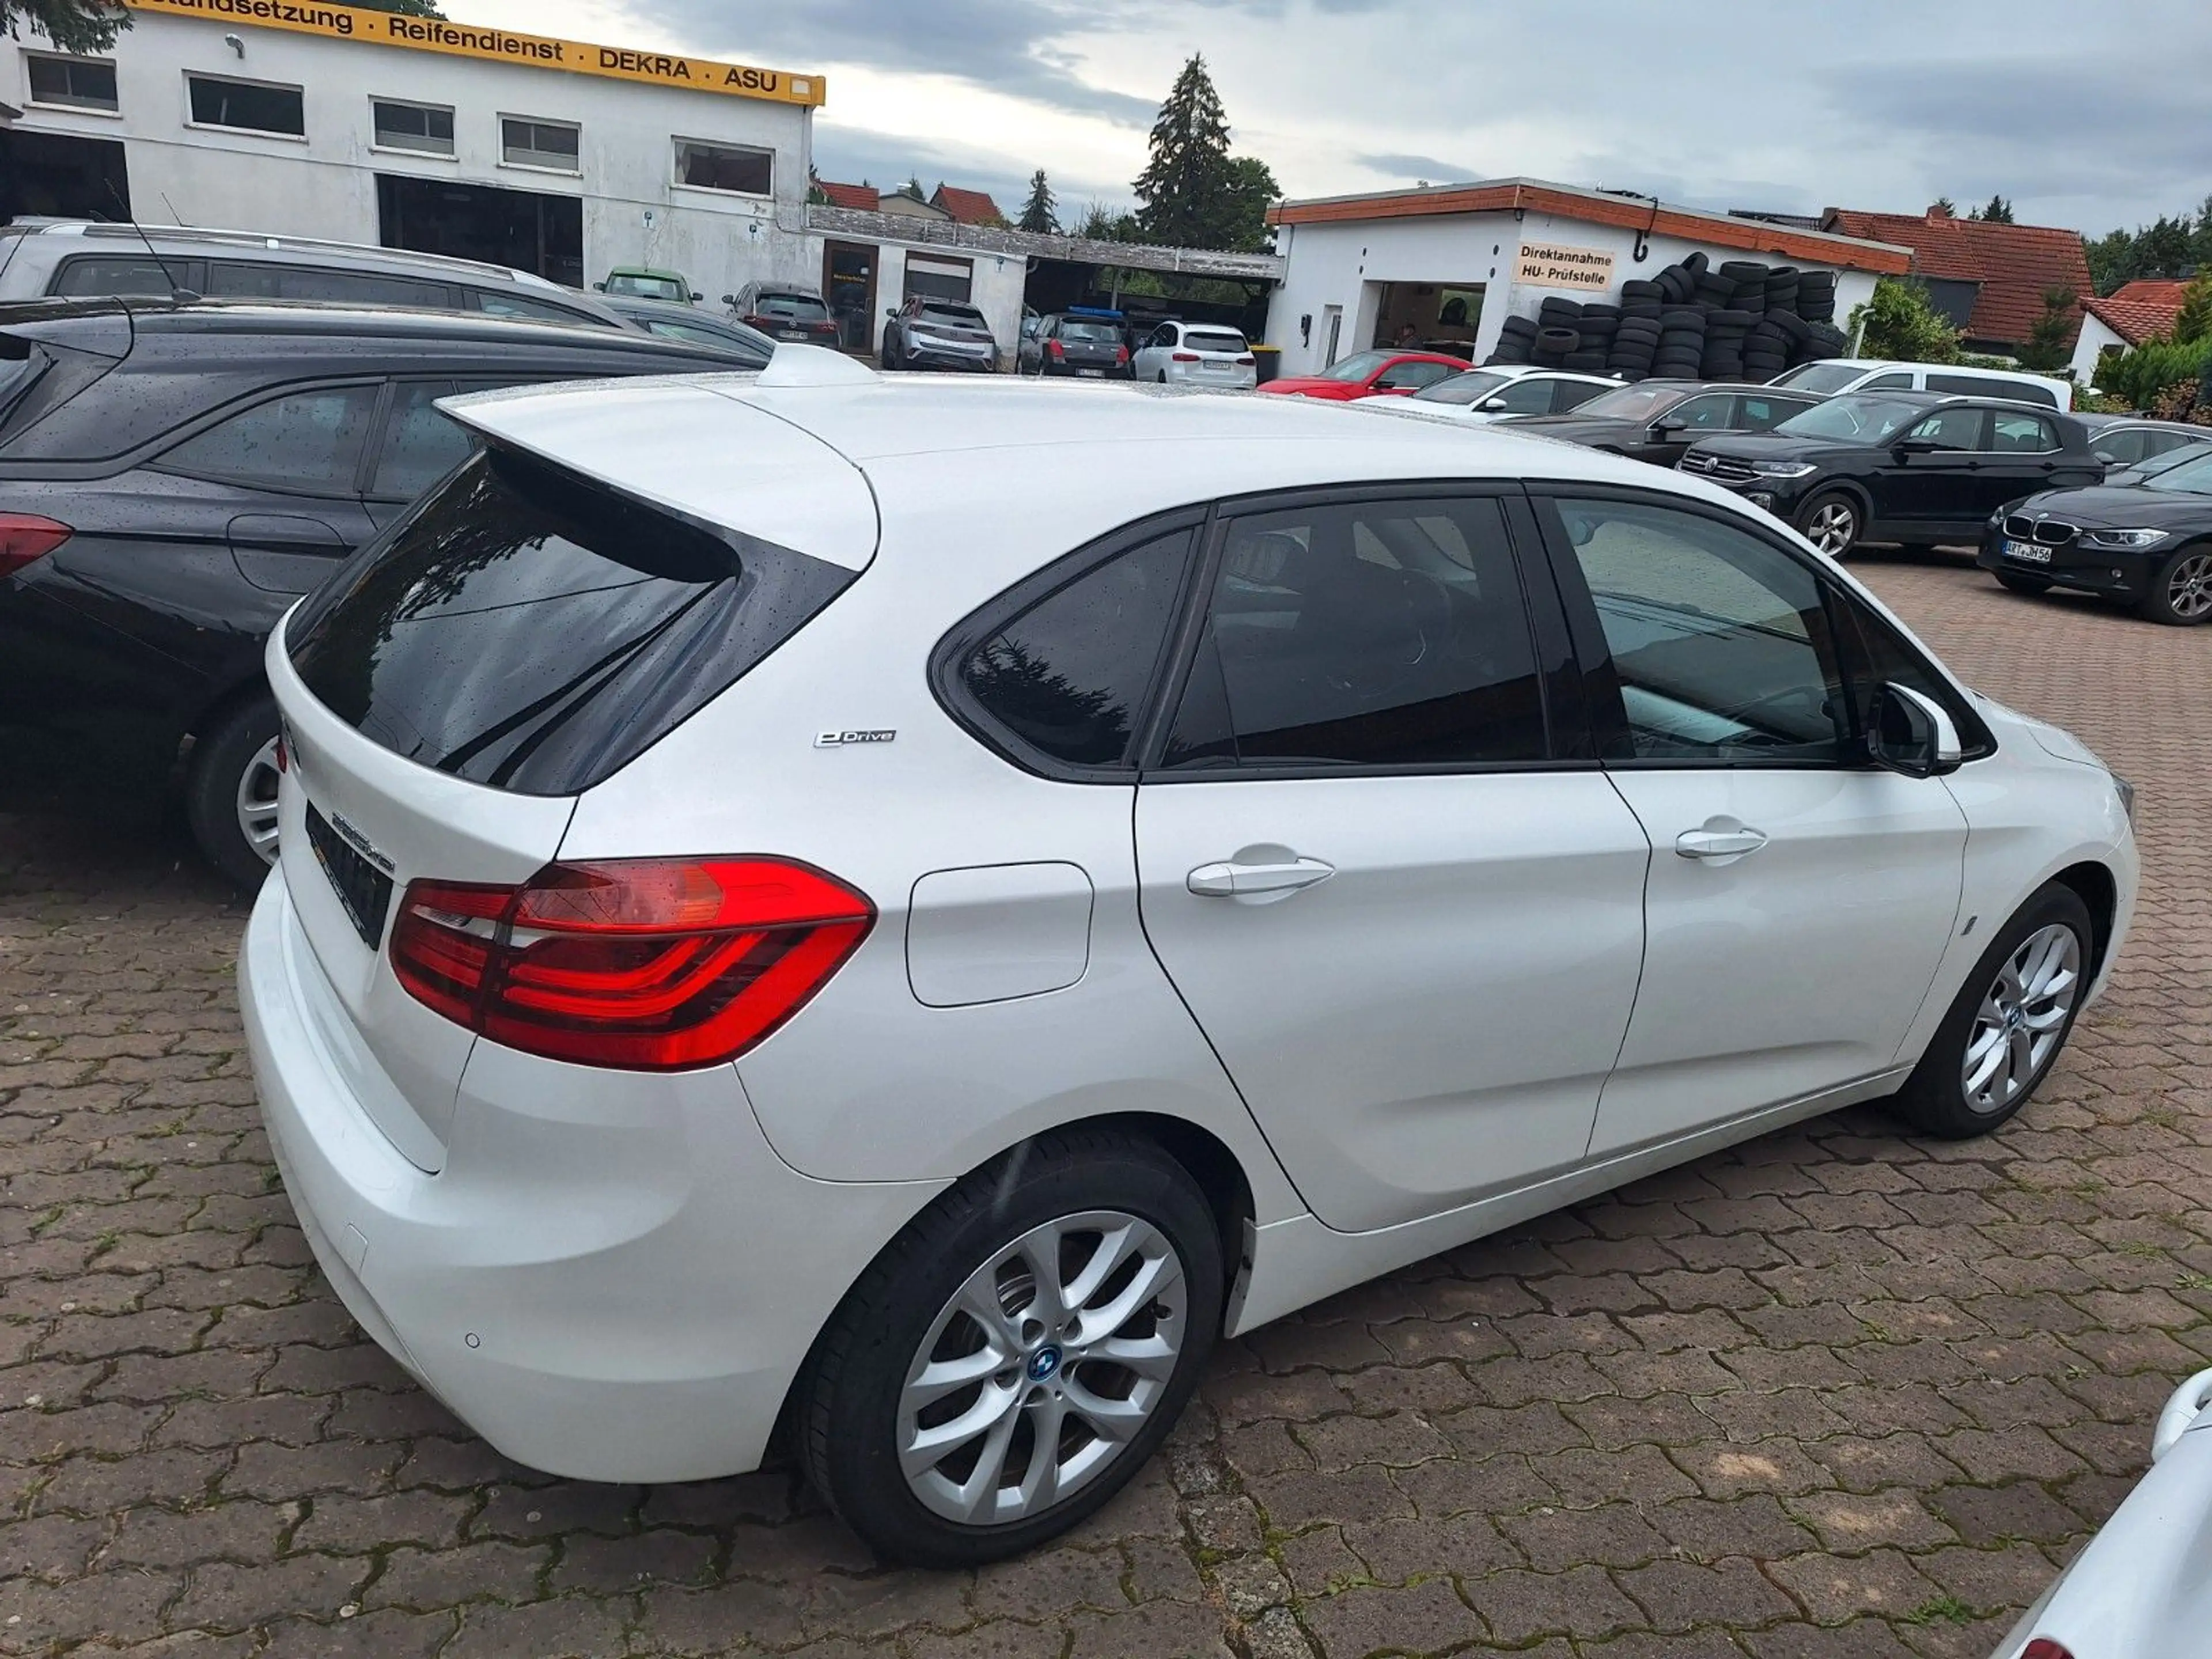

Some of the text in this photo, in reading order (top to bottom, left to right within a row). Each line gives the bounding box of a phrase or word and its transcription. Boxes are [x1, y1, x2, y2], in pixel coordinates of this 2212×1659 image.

[388, 17, 563, 62] Reifendienst
[600, 48, 691, 79] DEKRA
[724, 67, 777, 92] ASU
[1521, 245, 1612, 266] Direktannahme
[1548, 267, 1605, 284] Prüfstelle
[813, 730, 896, 748] eDrive
